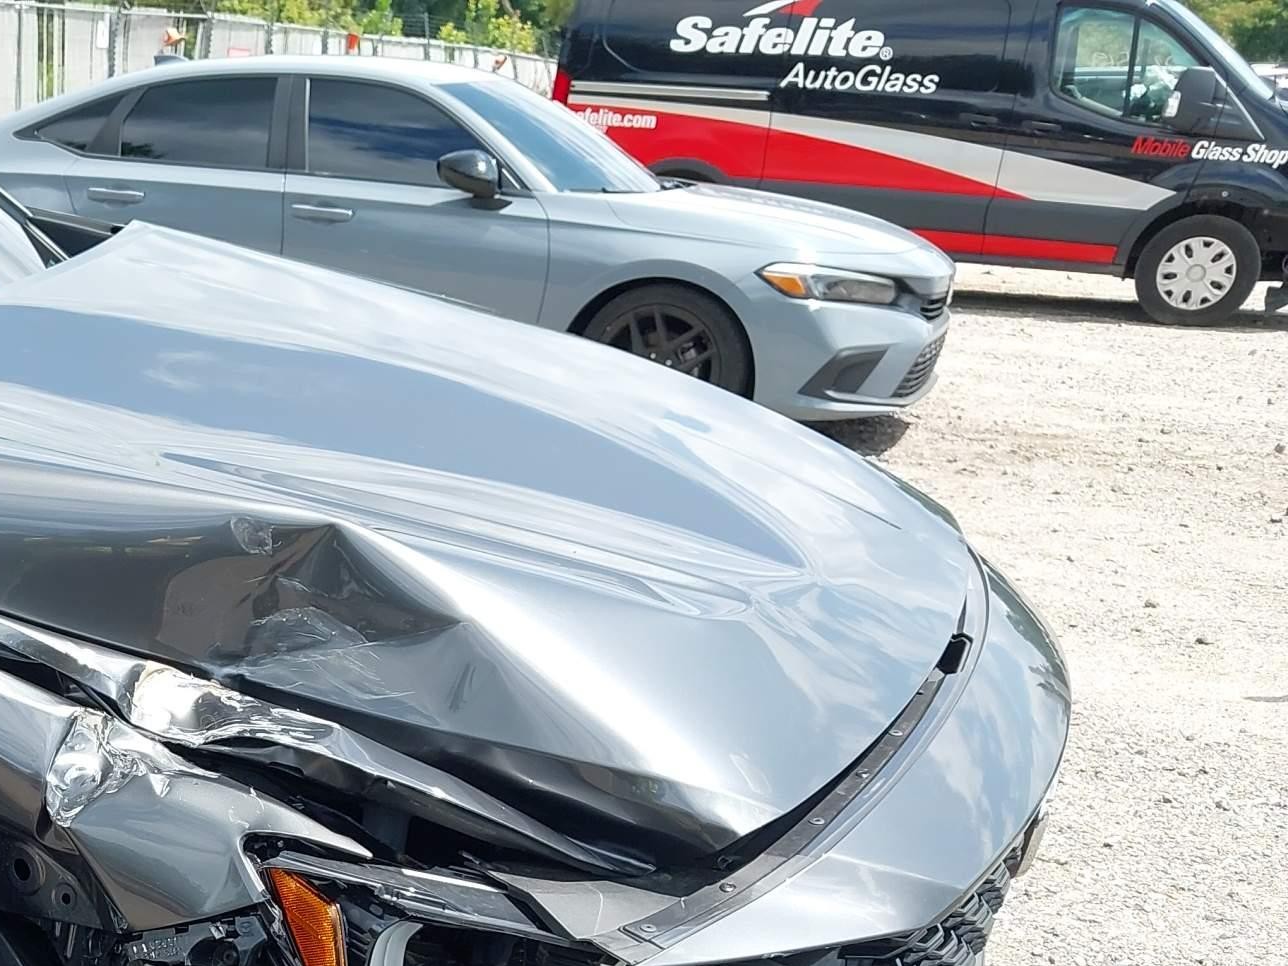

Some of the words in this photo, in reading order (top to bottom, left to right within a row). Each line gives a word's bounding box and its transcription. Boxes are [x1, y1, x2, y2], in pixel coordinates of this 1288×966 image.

[780, 62, 940, 94] AutoGlass
[1132, 135, 1192, 159] Mobile
[1191, 140, 1242, 161] Glass
[1242, 143, 1288, 169] Shop
